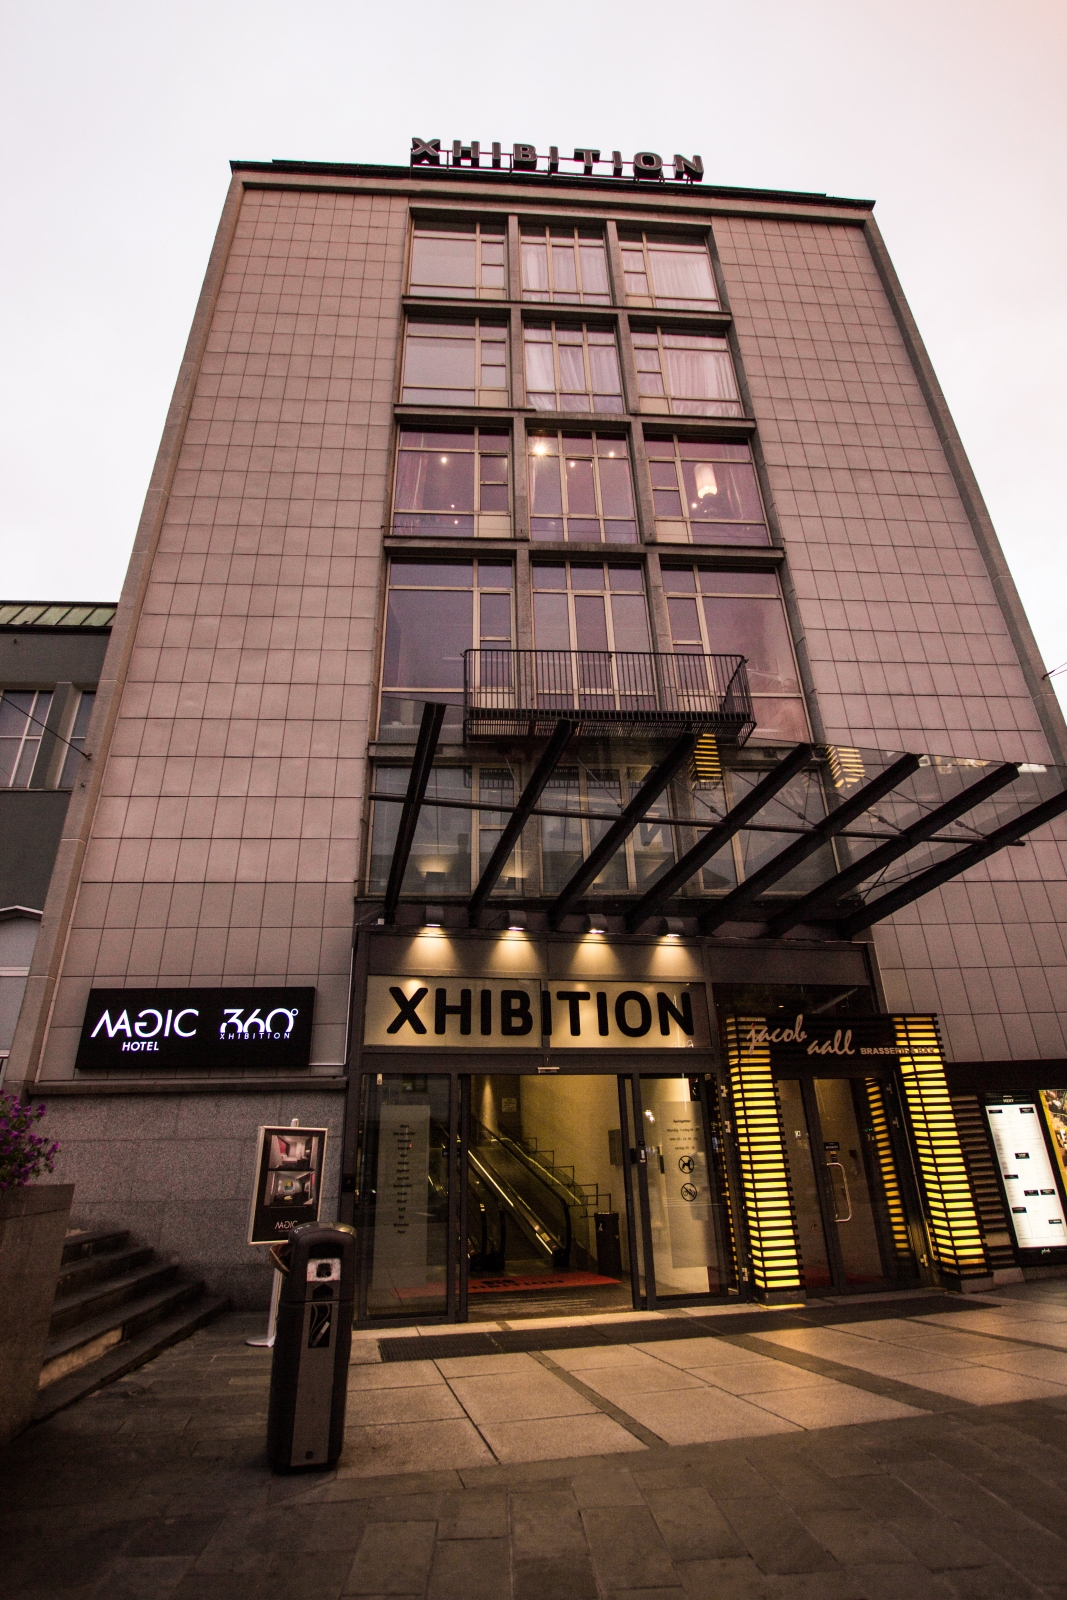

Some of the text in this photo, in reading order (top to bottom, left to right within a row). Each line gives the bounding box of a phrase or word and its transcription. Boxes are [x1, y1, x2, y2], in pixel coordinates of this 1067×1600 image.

[410, 137, 704, 181] XHIBITION
[386, 986, 695, 1038] XHIBITION
[90, 1008, 199, 1038] MAGIC
[219, 1032, 291, 1040] XHIBITION
[122, 1041, 160, 1052] HOTEL
[860, 1047, 909, 1055] BRASSERIE
